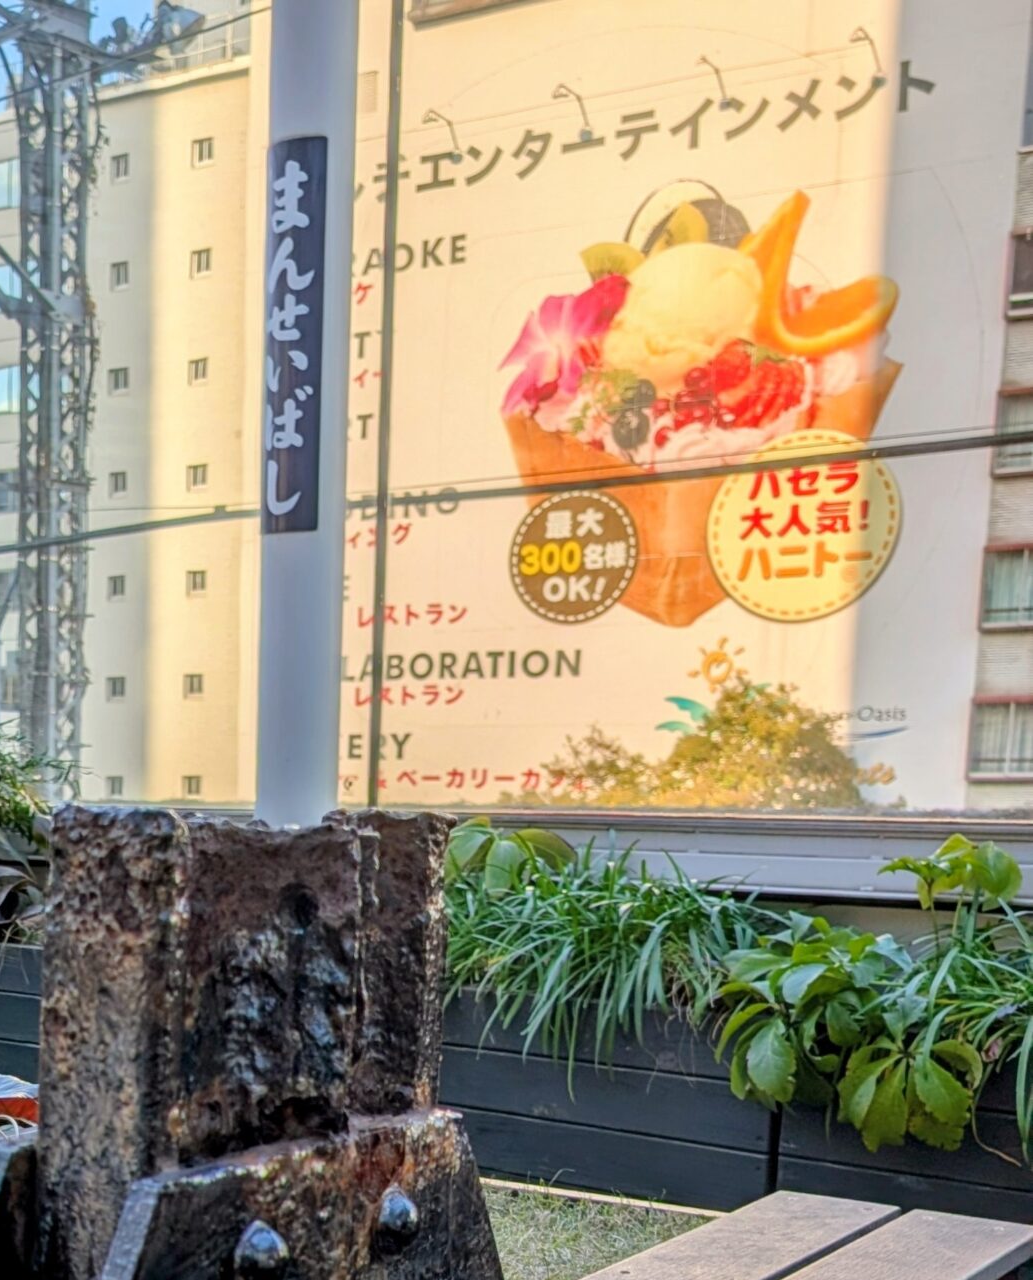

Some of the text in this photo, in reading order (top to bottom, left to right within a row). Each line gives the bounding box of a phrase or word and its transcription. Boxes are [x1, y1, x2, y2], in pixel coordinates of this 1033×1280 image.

[351, 233, 467, 277] AOKE
[265, 158, 316, 517] まんせいばし
[544, 507, 605, 539] 最大
[737, 540, 873, 581] ハニトー
[542, 574, 607, 603] OK!
